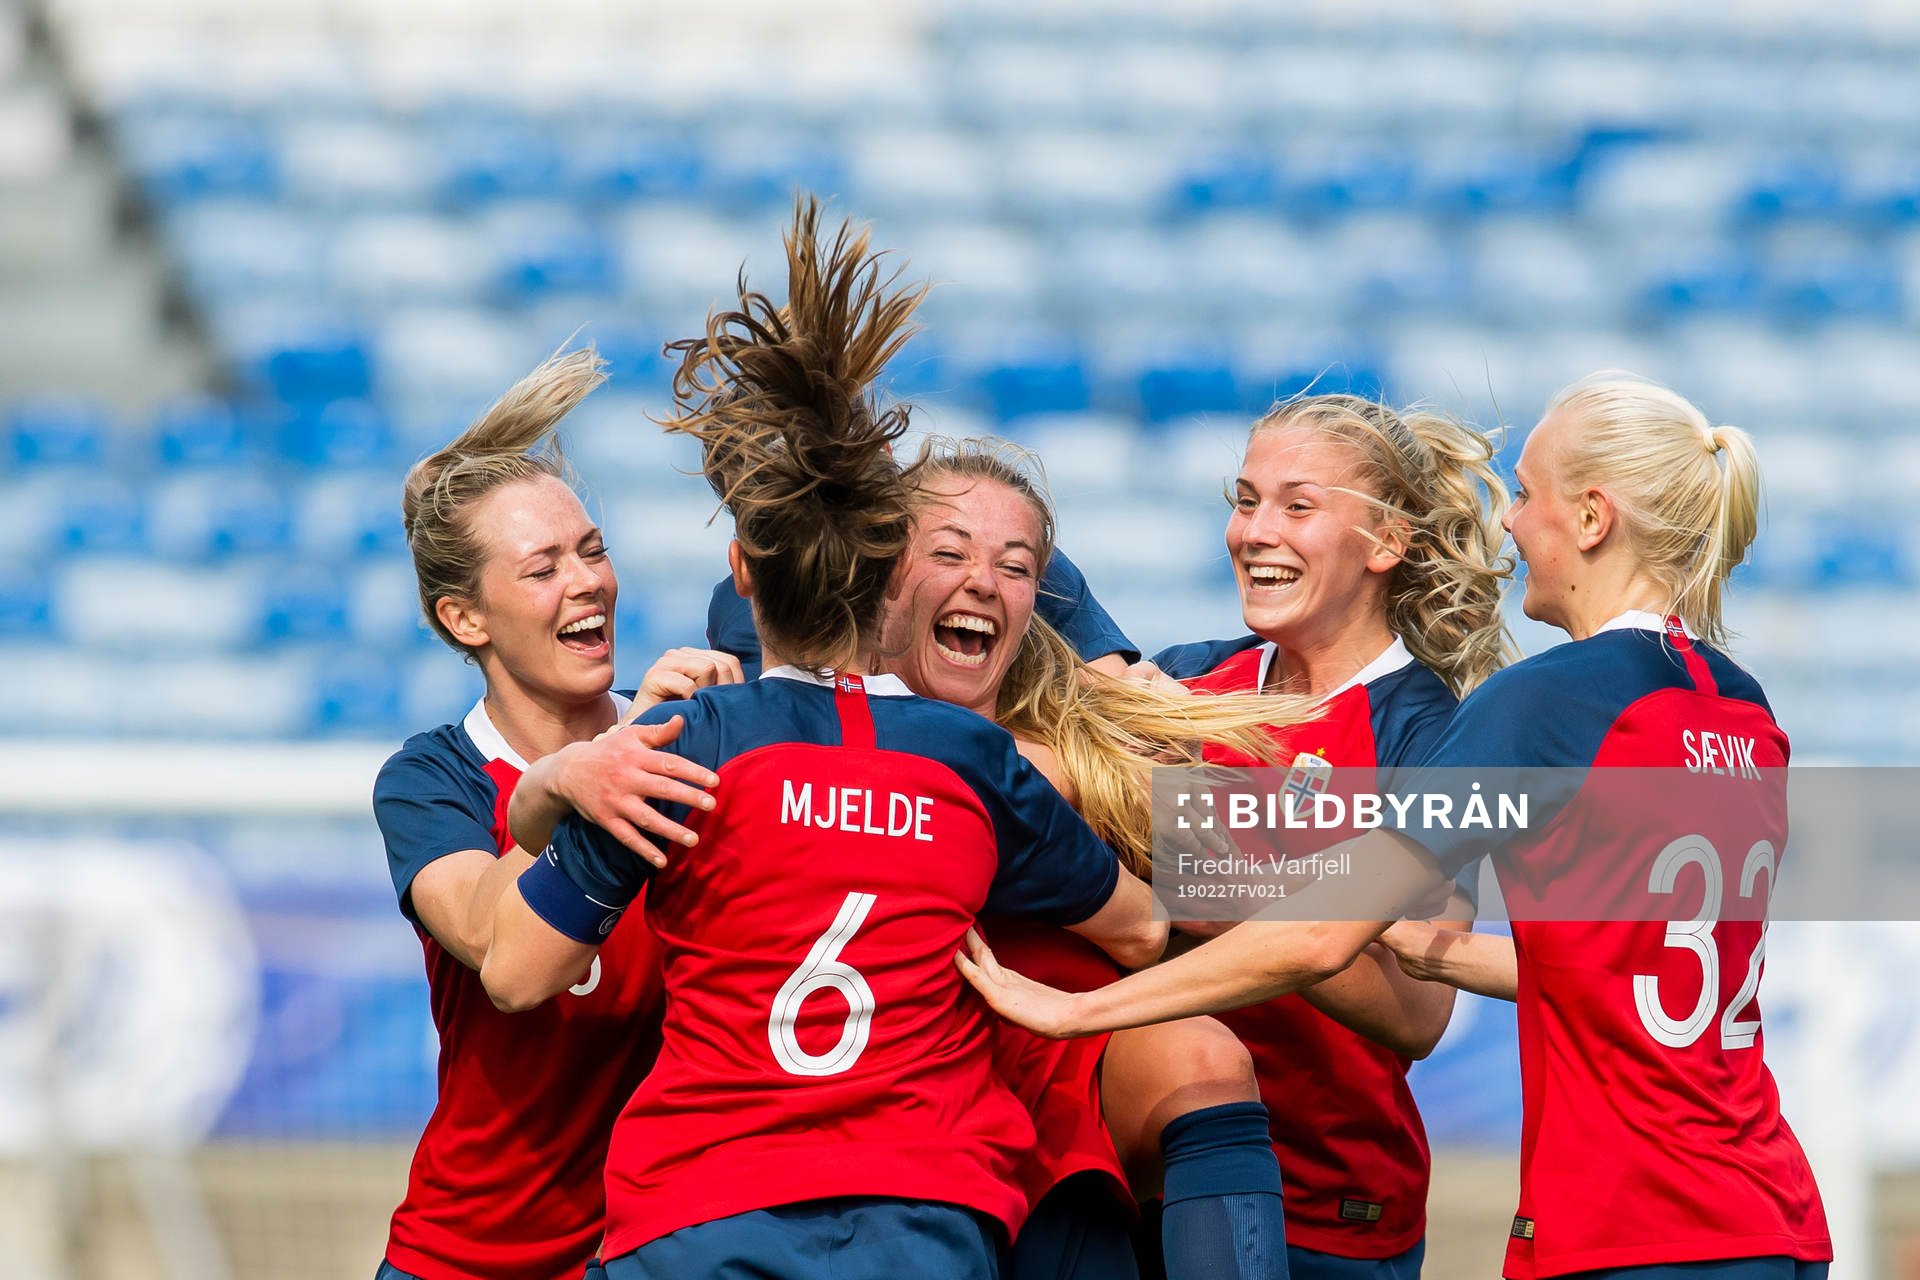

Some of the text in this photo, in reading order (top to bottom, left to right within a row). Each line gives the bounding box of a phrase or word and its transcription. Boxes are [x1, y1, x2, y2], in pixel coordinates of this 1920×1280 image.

[780, 779, 935, 842] MJELDE
[1682, 729, 1762, 781] SÆVIK
[768, 891, 878, 1077] 6
[1633, 834, 1776, 1050] 32
